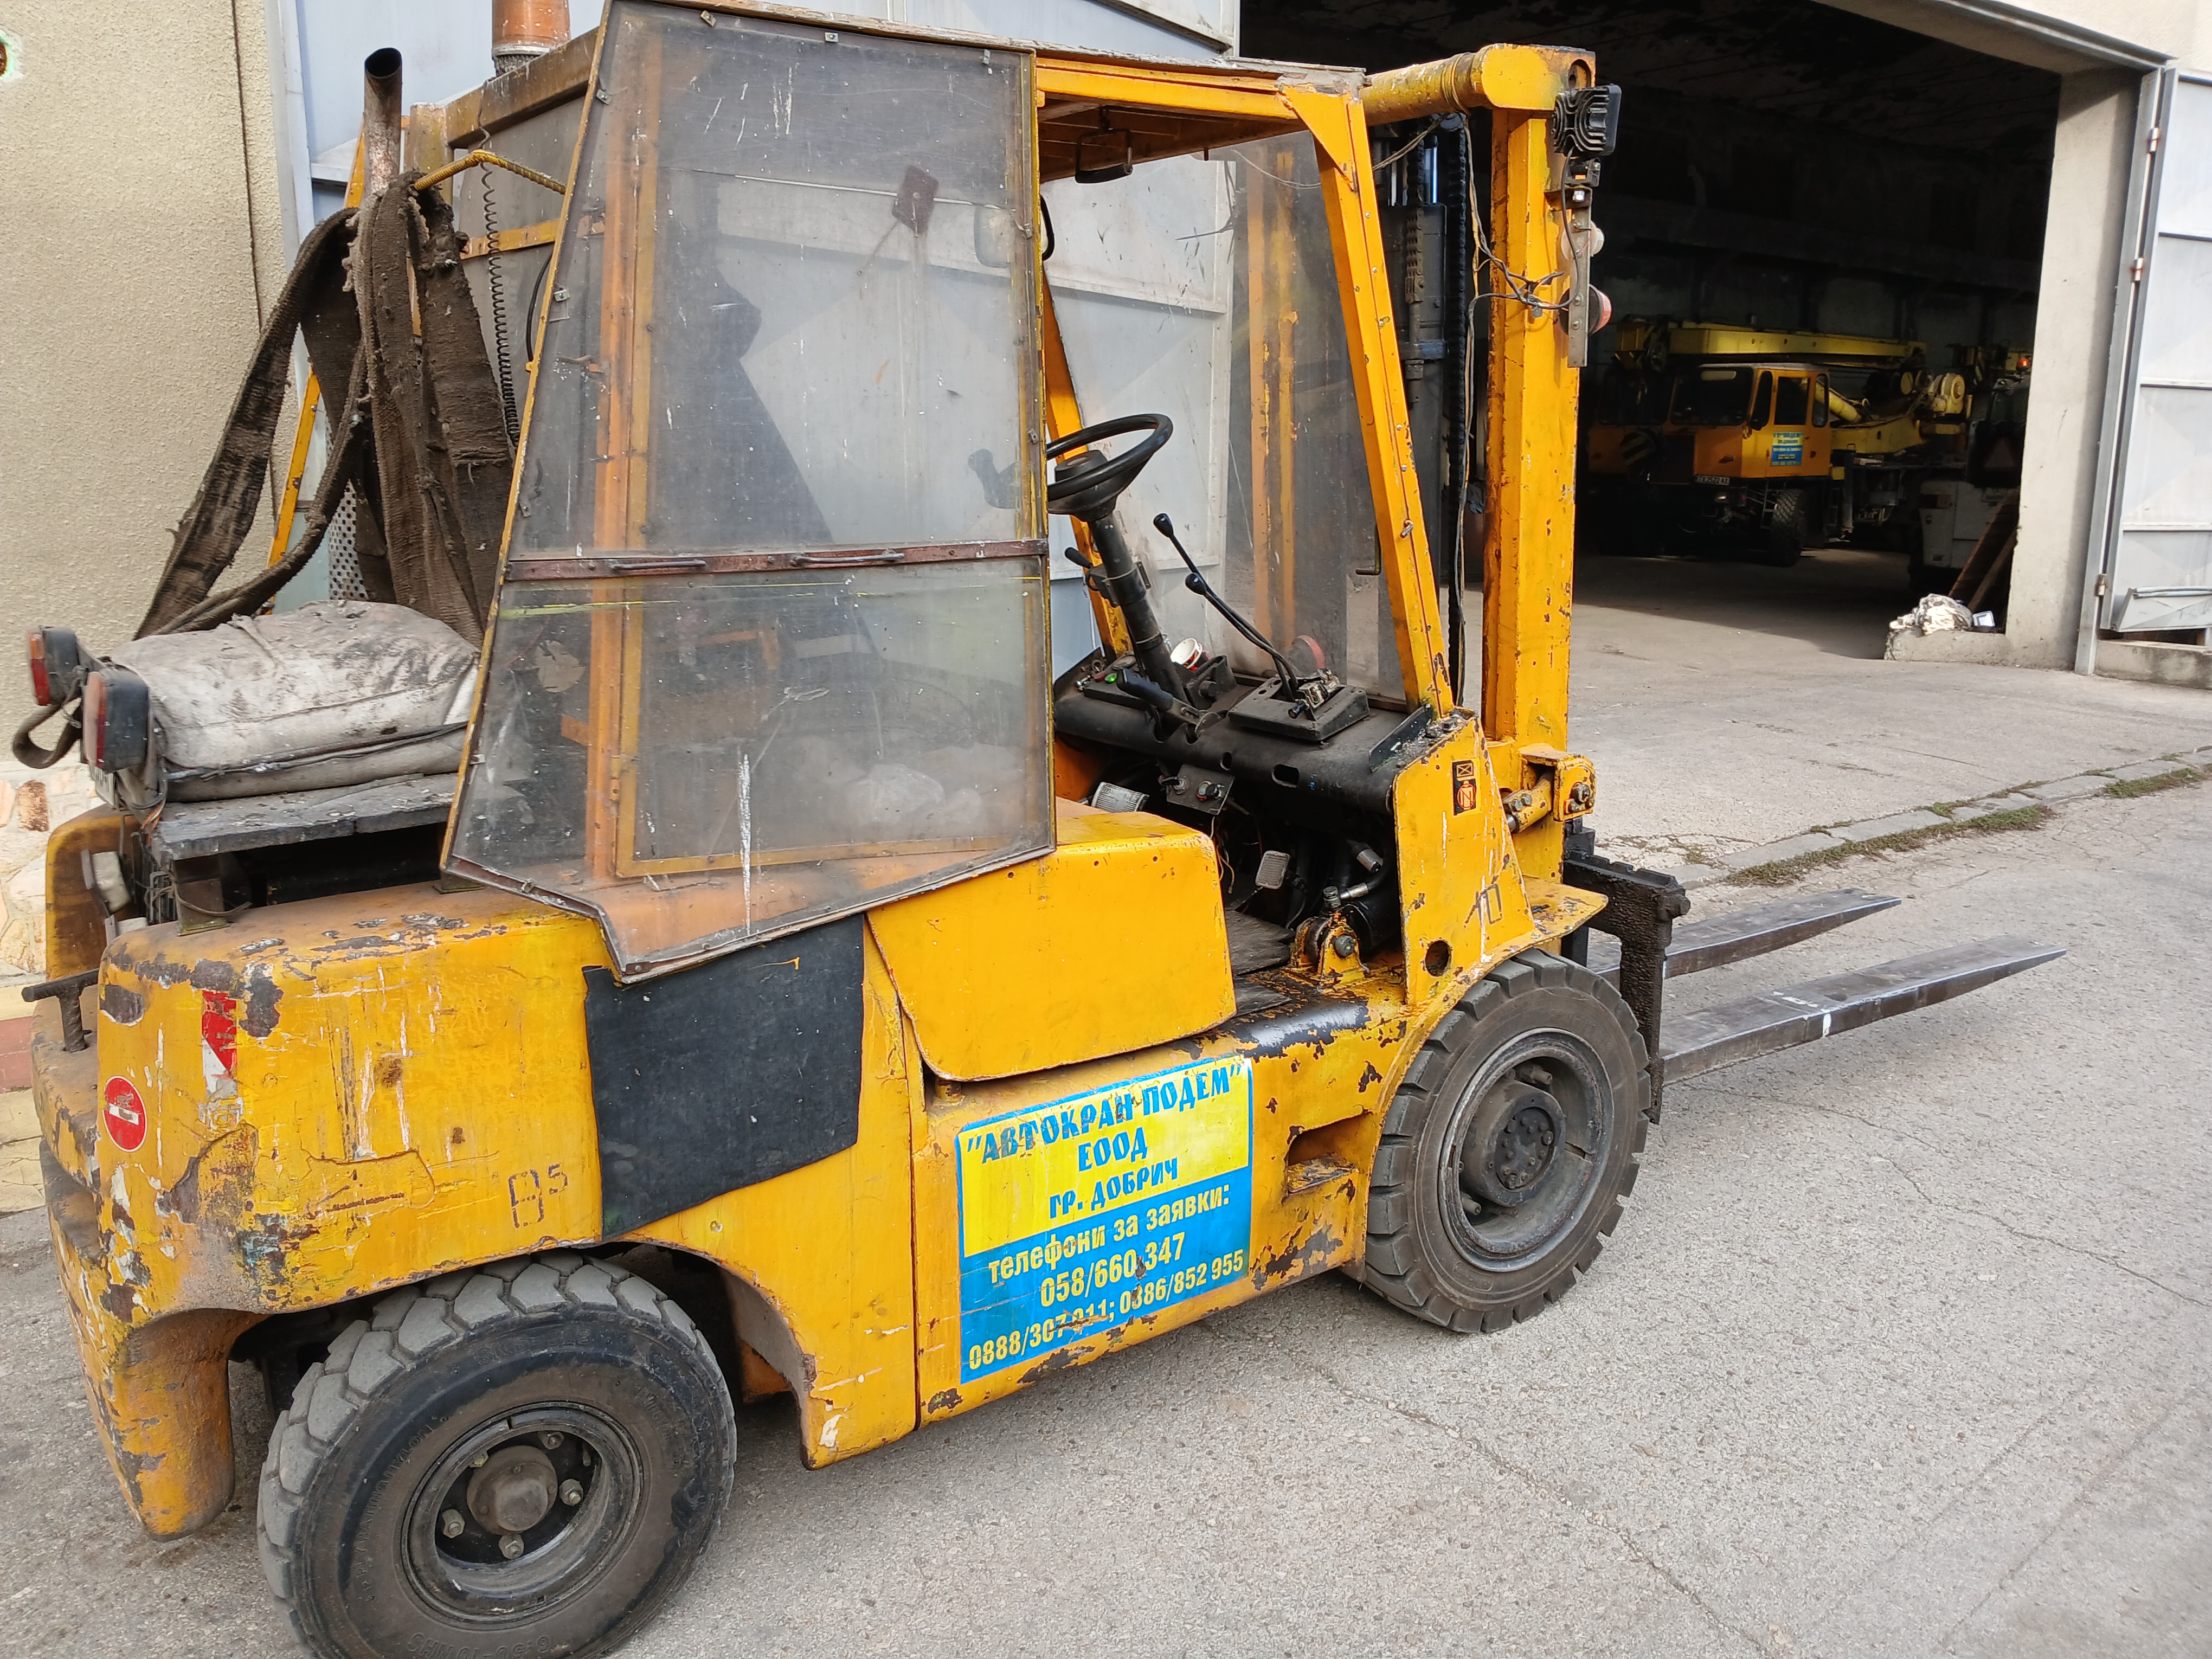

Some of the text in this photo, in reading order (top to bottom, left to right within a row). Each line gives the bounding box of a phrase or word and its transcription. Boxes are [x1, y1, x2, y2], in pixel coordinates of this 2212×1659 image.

[1078, 1127, 1148, 1172] ЕООД
[1050, 1157, 1178, 1219] ГР. ДОБРИЧ
[988, 1184, 1230, 1283] телефони за заявки:
[1040, 1231, 1185, 1307] 058/660 347
[969, 1313, 1067, 1369] 0888/307
[1211, 1249, 1244, 1281] 955
